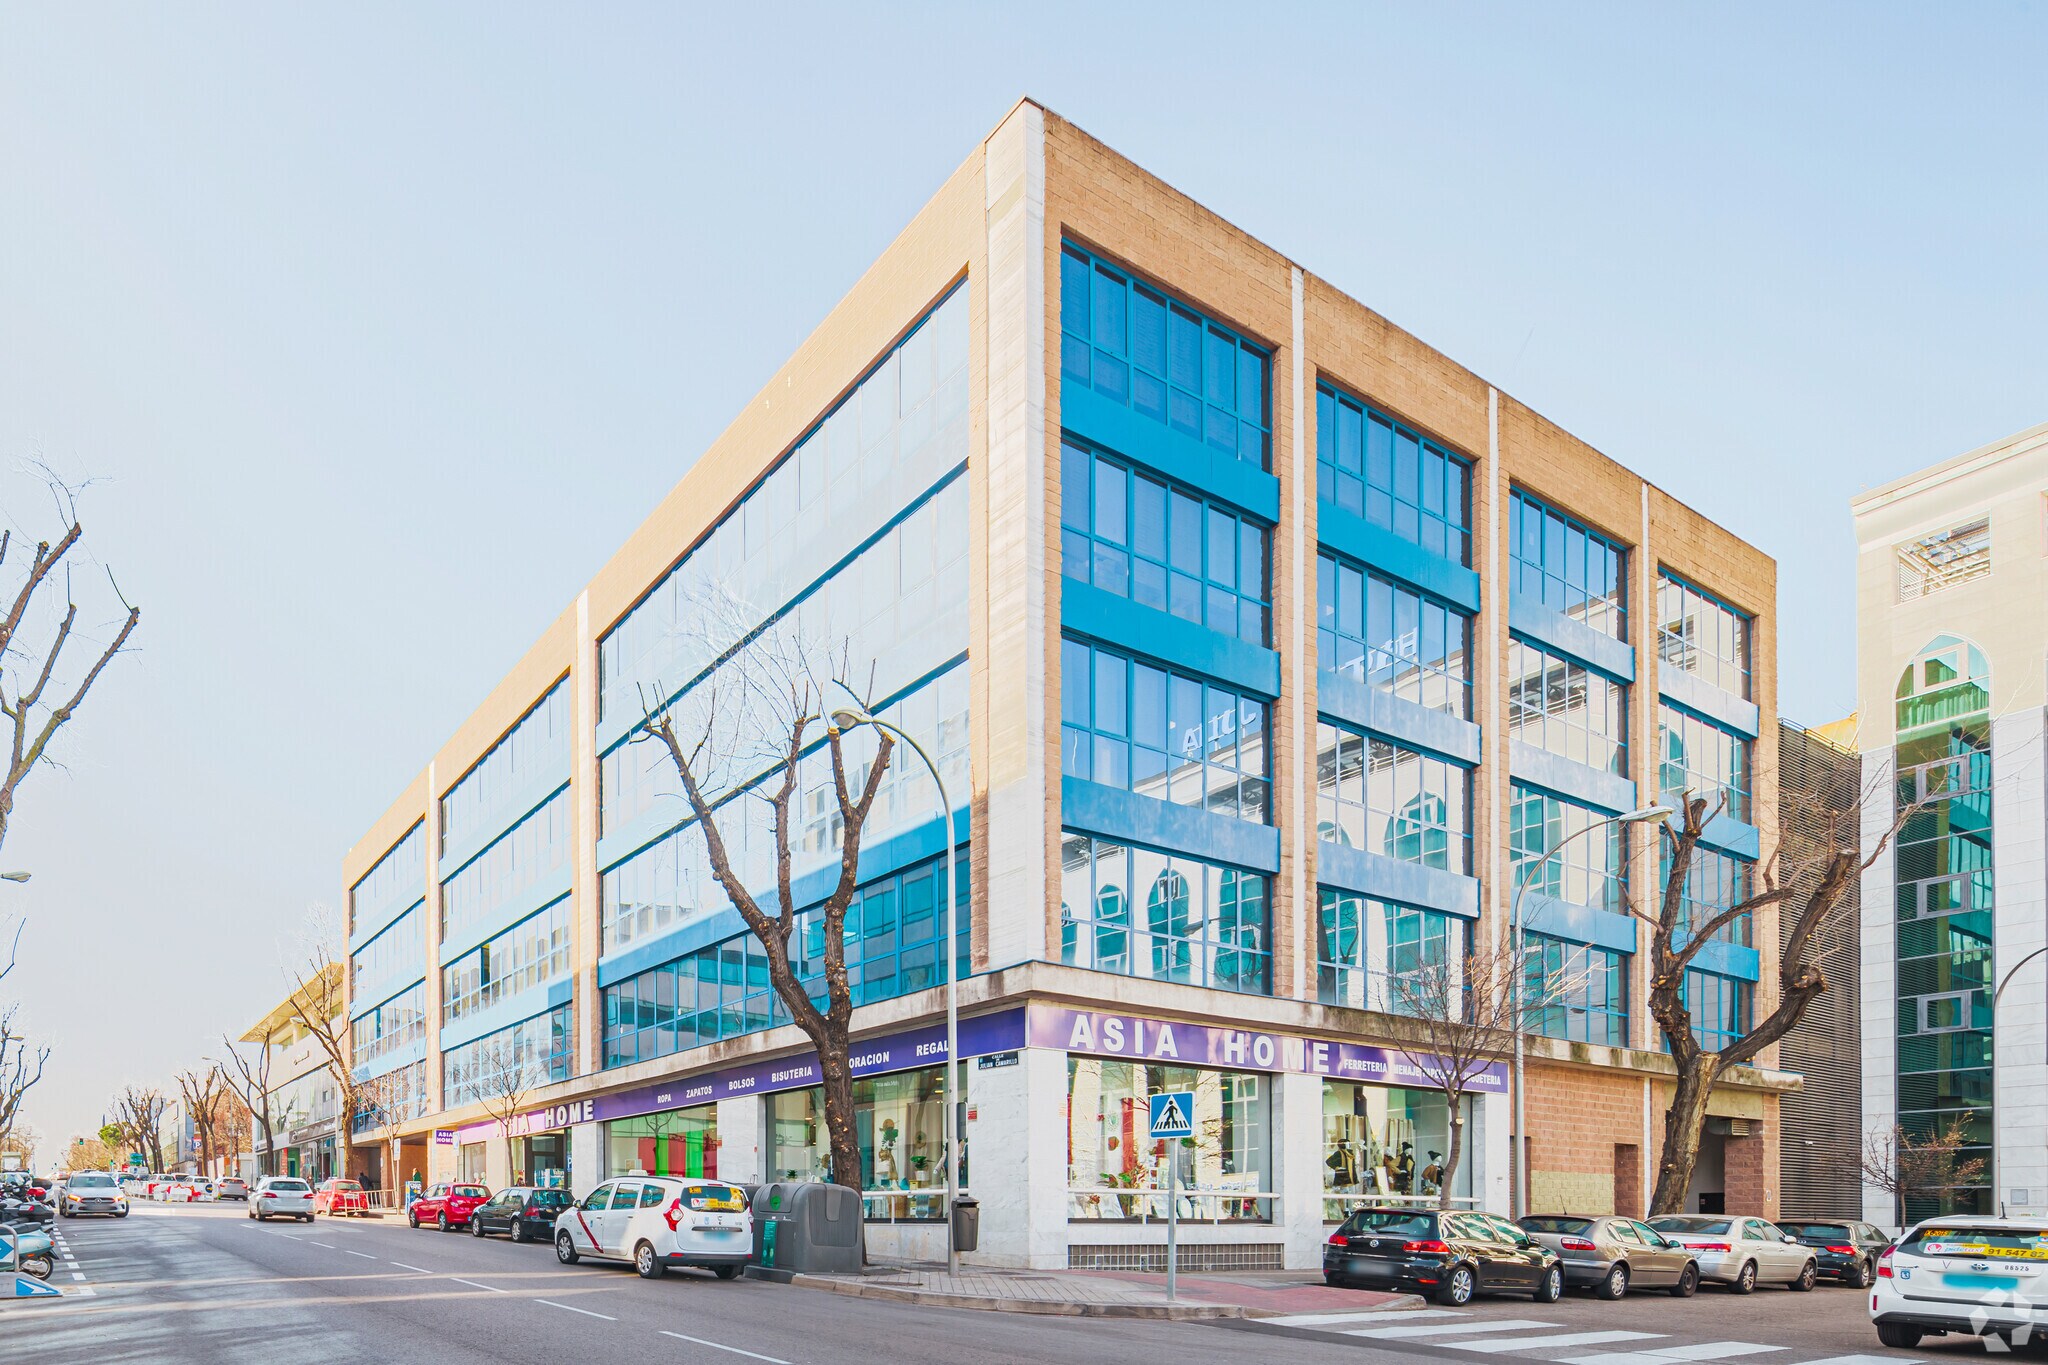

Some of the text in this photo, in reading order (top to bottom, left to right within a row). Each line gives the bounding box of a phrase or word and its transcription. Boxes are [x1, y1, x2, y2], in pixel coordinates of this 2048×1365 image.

[1068, 1014, 1330, 1073] ASIA HOME
[657, 1040, 949, 1104] ROPA ZAPATOS BOLSOS BISUTERIA ORACION REGAL
[1343, 1058, 1388, 1073] FERRETERIA
[1392, 1063, 1420, 1077] MENAJE
[545, 1099, 594, 1129] HOME
